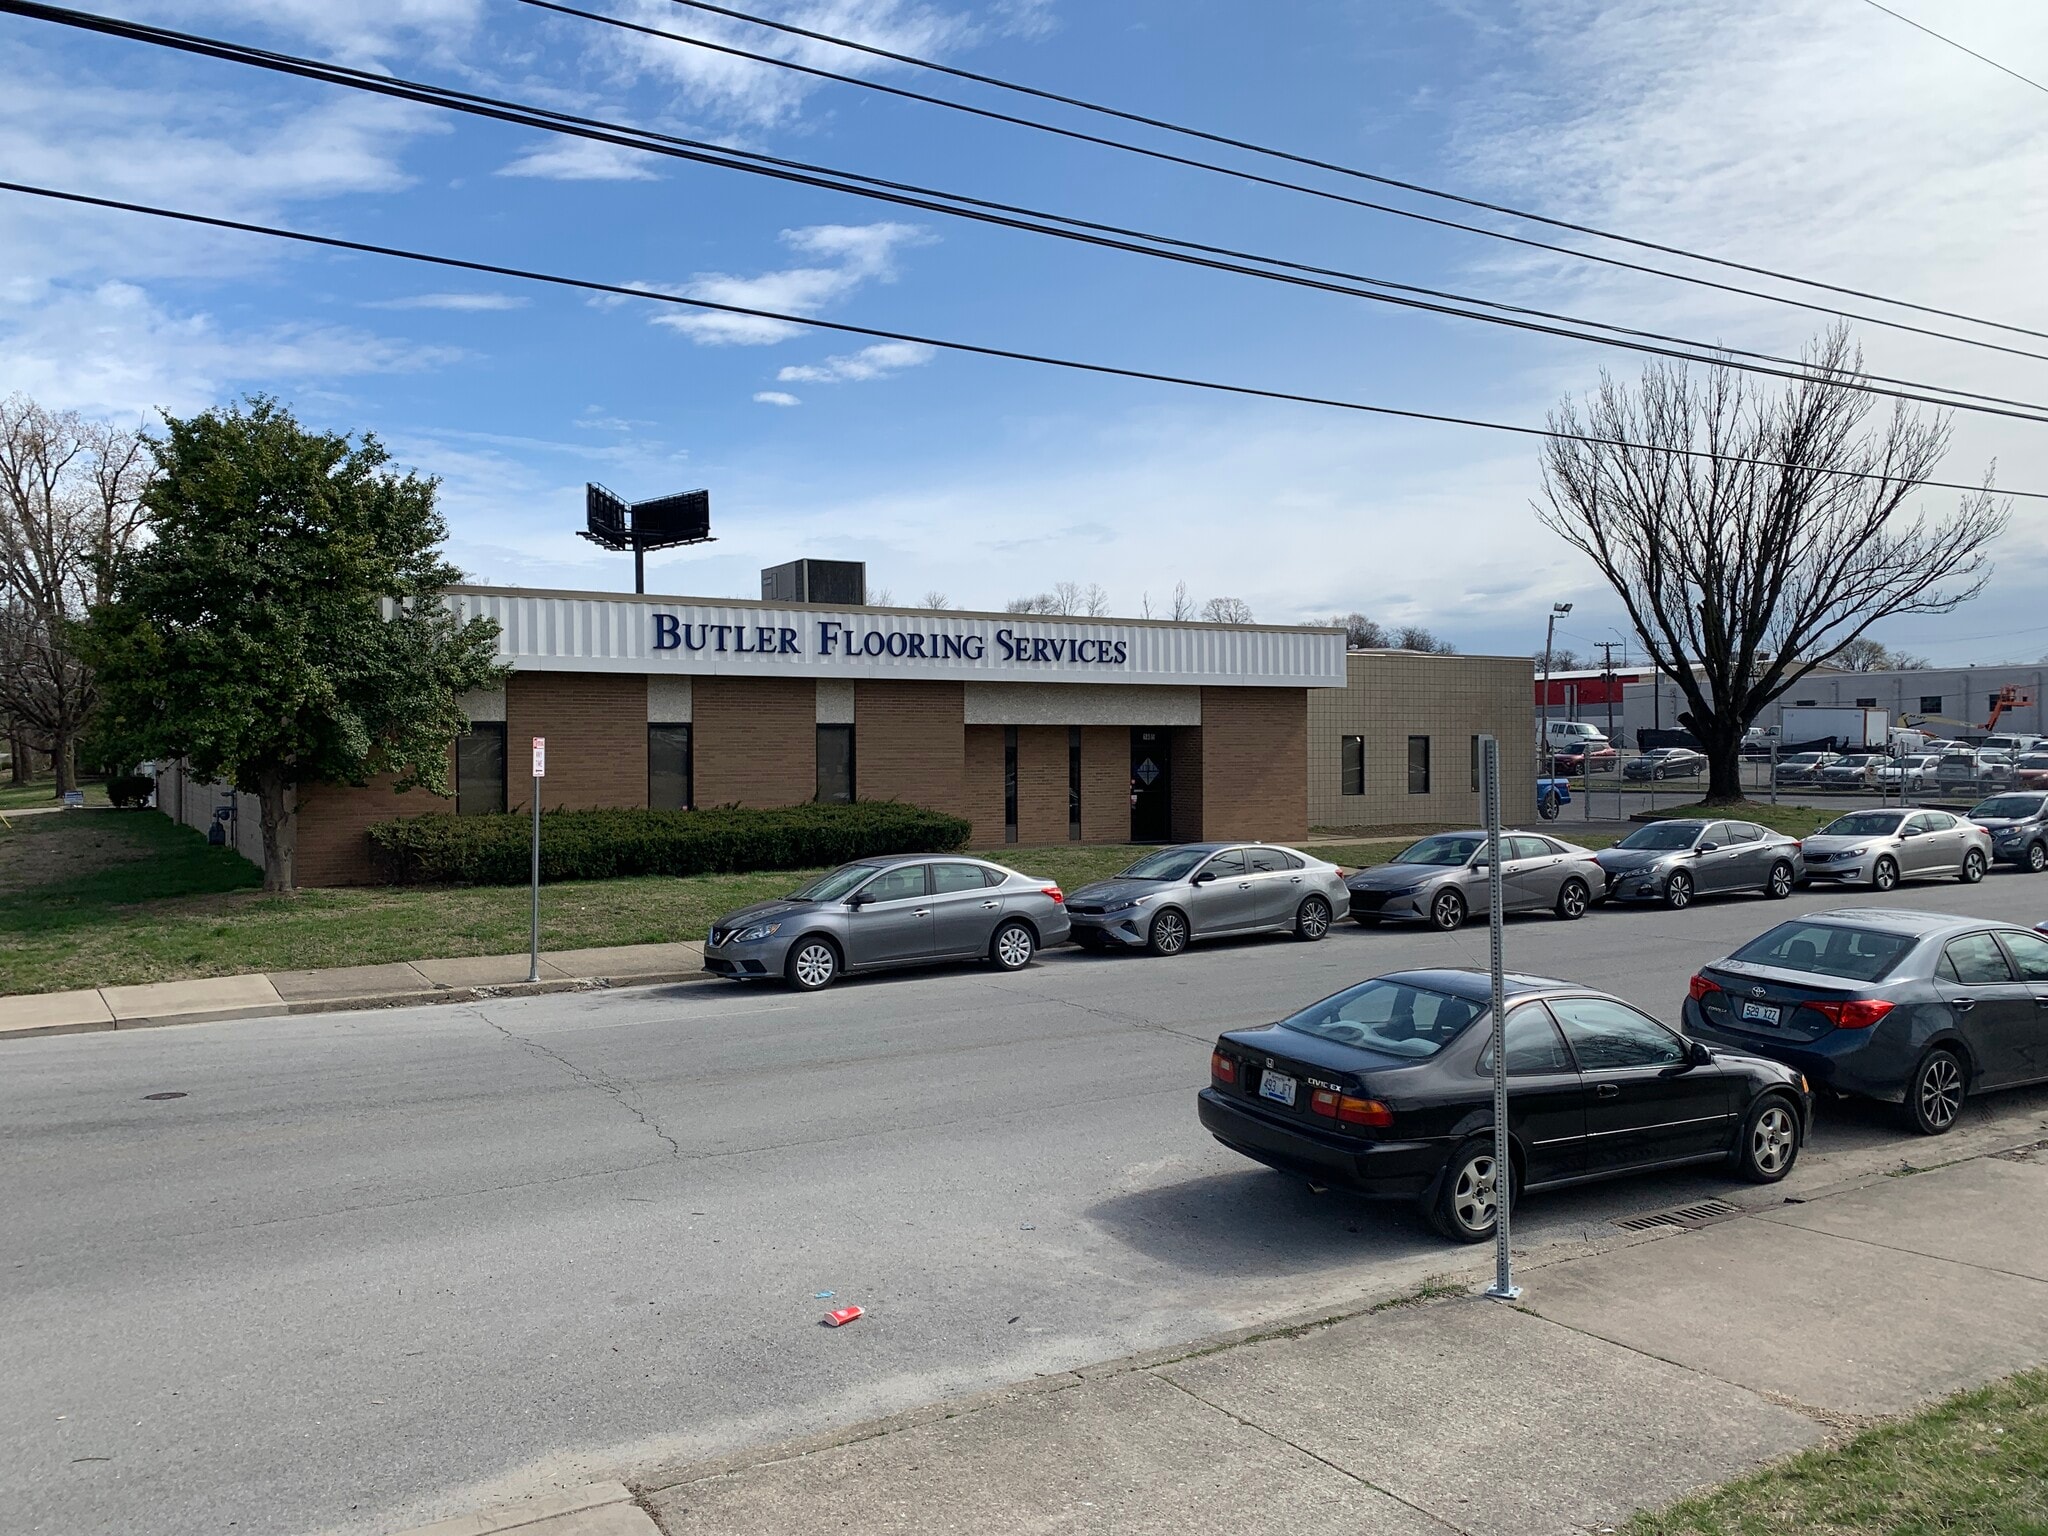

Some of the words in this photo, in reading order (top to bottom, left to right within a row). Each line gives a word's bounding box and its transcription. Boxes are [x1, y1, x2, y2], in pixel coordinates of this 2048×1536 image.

[652, 613, 801, 655] BUTLER
[817, 621, 983, 660] FLOORING
[996, 629, 1127, 664] SERVICES
[1307, 1077, 1329, 1089] CIVIC
[1330, 1083, 1342, 1092] EX
